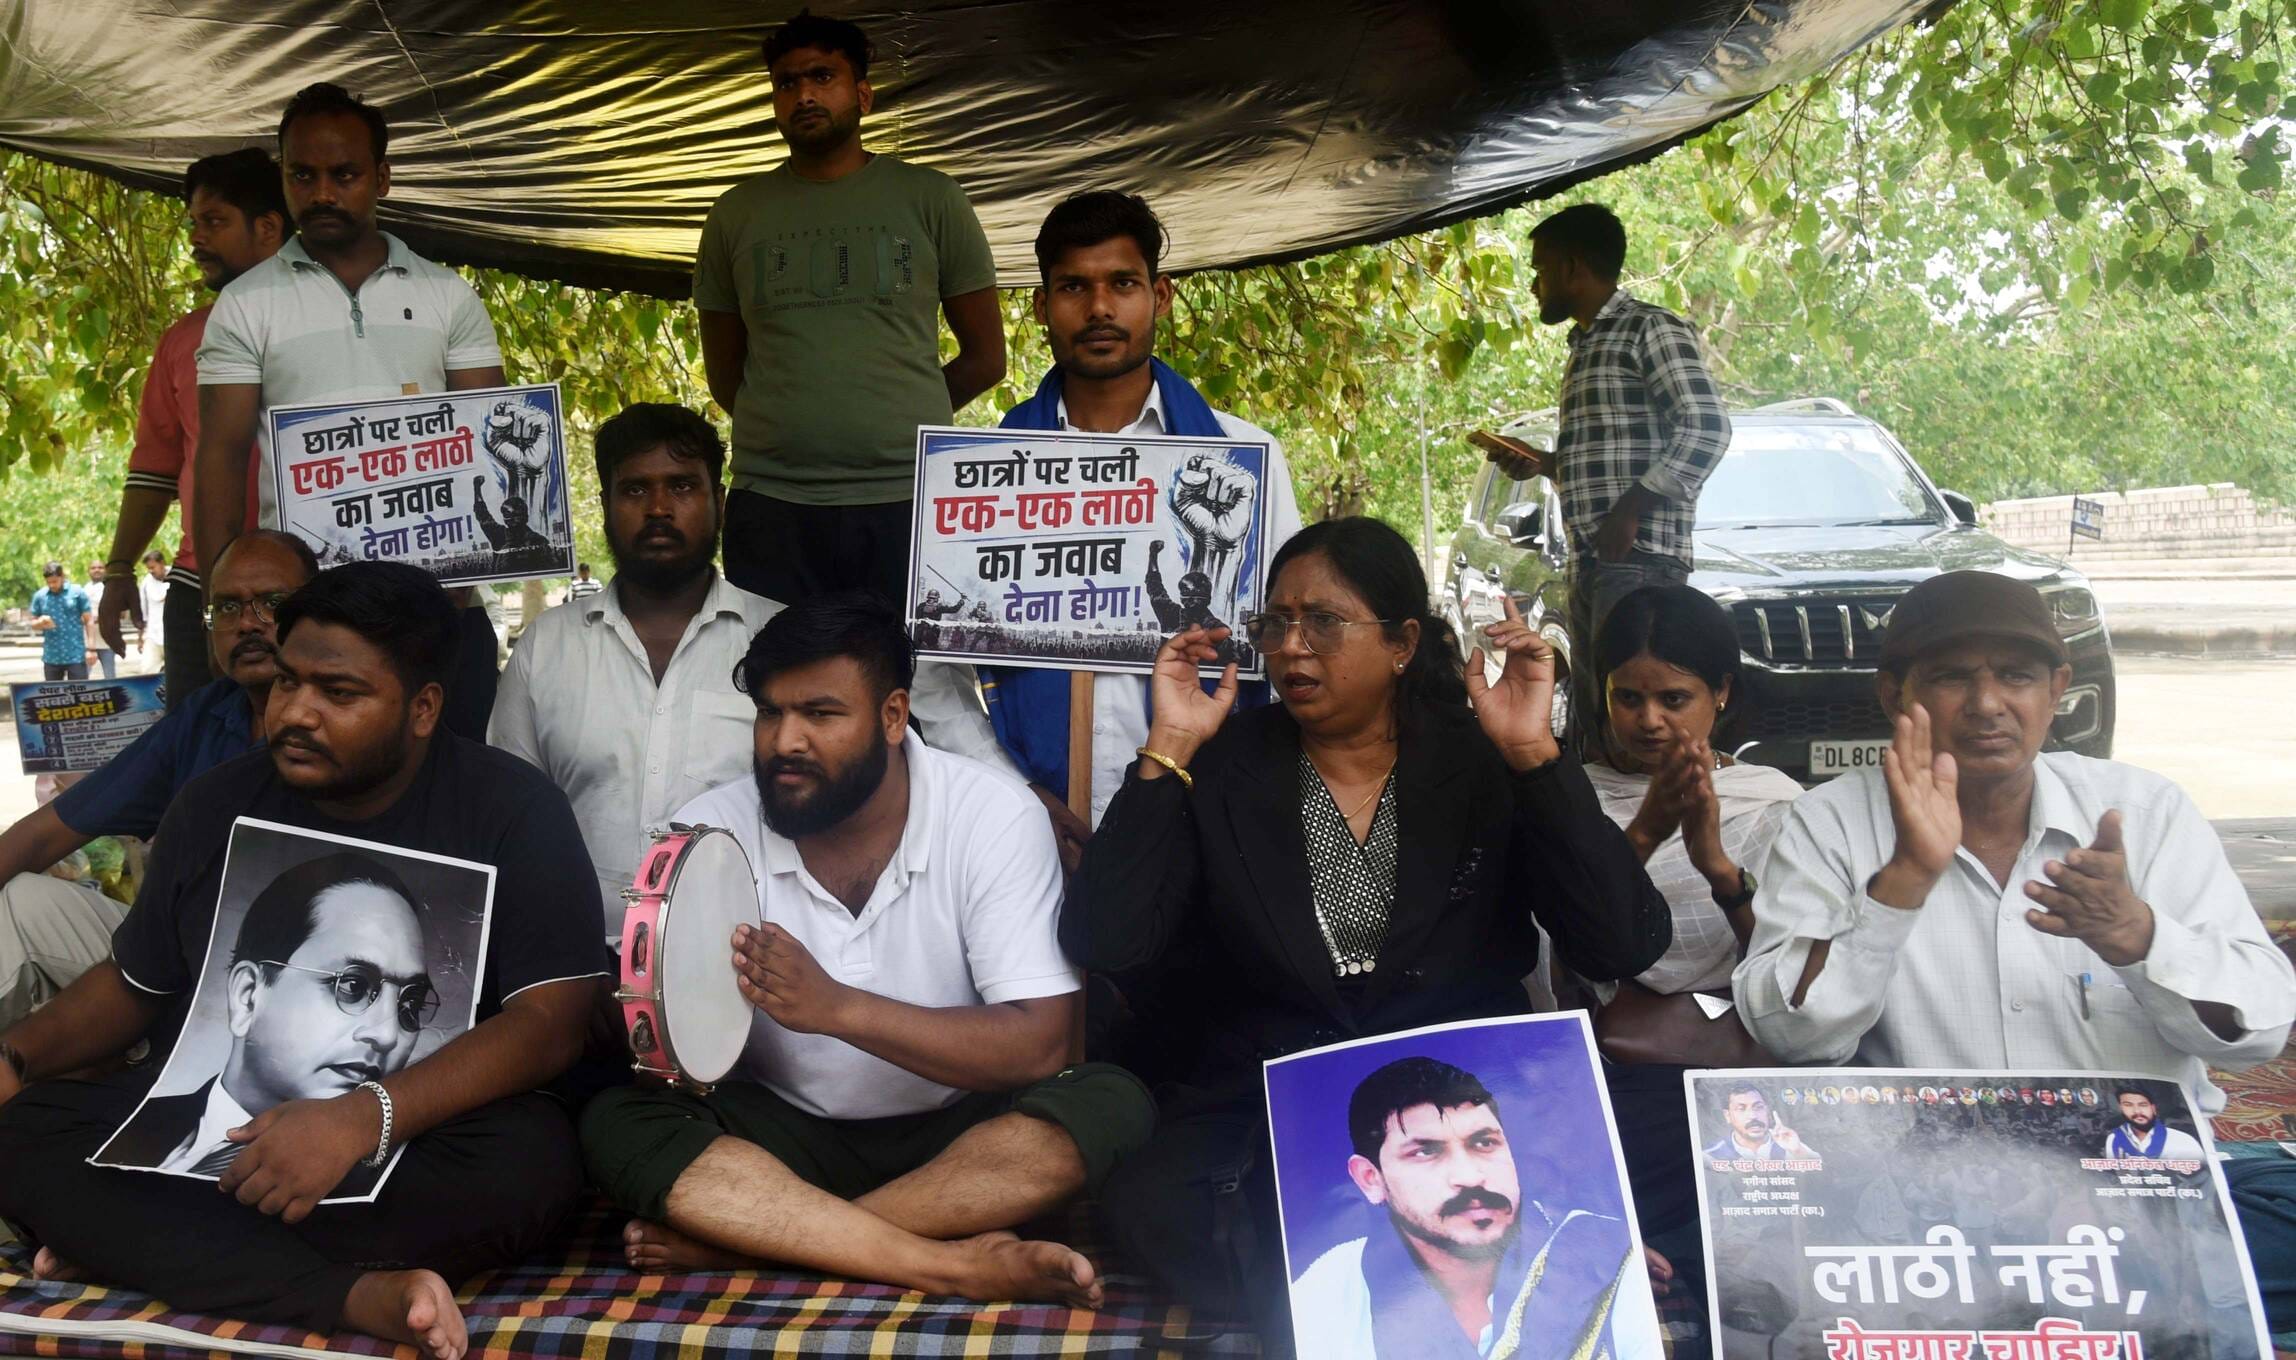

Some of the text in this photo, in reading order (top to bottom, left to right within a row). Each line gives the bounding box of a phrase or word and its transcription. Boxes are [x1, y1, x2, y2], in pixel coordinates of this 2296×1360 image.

[302, 402, 455, 454] छात्रों पर चली
[290, 425, 474, 495] एक-एक लाठी
[954, 447, 1140, 489] छात्रों पर चली
[332, 478, 454, 528] का जवाब
[933, 477, 1159, 535] एक-एक लाठी
[360, 514, 474, 561] देना होगा!
[976, 538, 1126, 582] का जवाब
[1003, 578, 1142, 625] देना होगा!
[1804, 1223, 2148, 1315] लाठी नहीं,
